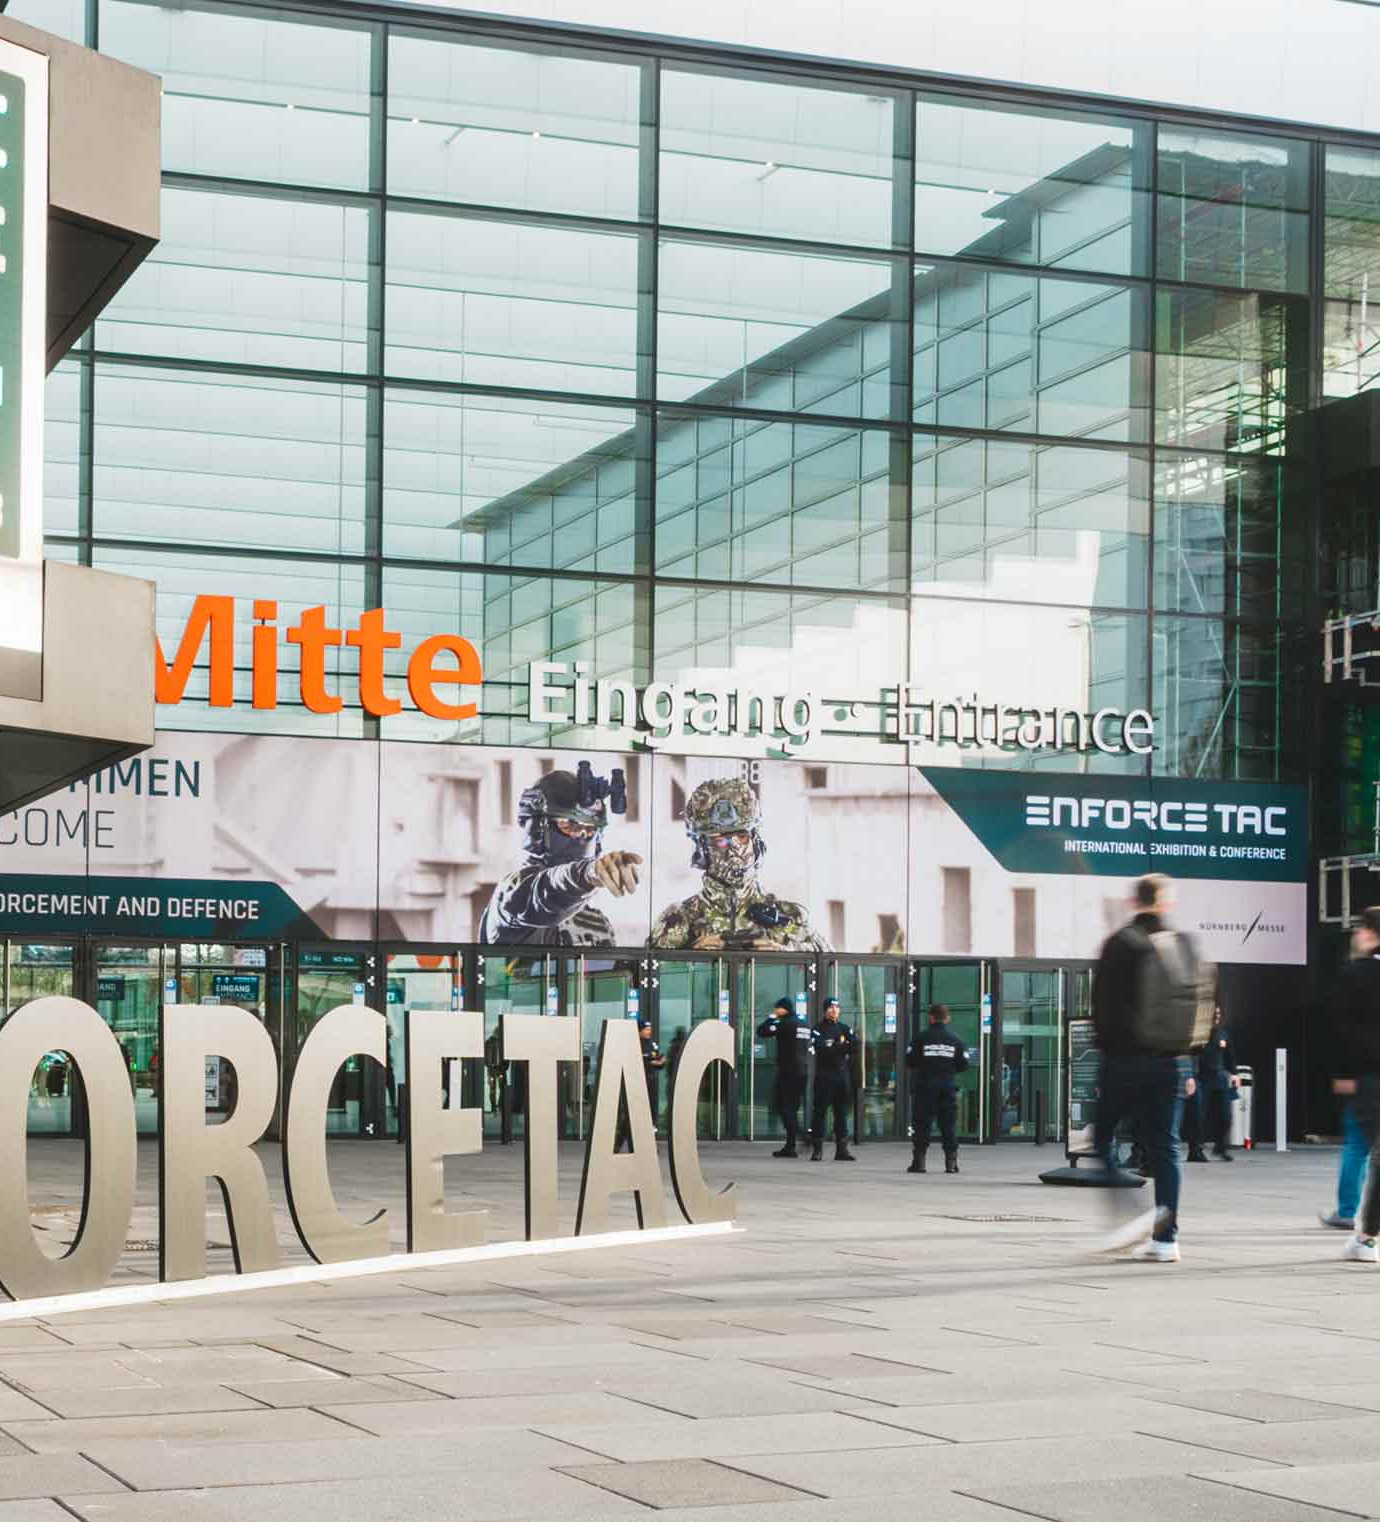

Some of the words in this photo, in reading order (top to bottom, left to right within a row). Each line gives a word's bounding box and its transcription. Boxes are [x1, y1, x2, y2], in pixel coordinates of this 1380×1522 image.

[155, 594, 483, 720] Mitte
[528, 660, 817, 749] Eingang
[895, 680, 1154, 754] Entrance
[1026, 795, 1208, 832] ENFORCE
[1213, 803, 1286, 836] TAC
[1064, 839, 1147, 855] INTERNATIONAL
[1150, 842, 1207, 857] EXHIBITION
[1208, 844, 1217, 857] &
[1219, 846, 1287, 860] CONFERENCE
[116, 896, 160, 917] AND
[167, 898, 260, 920] DEFENCE
[1257, 924, 1285, 933] MESSE
